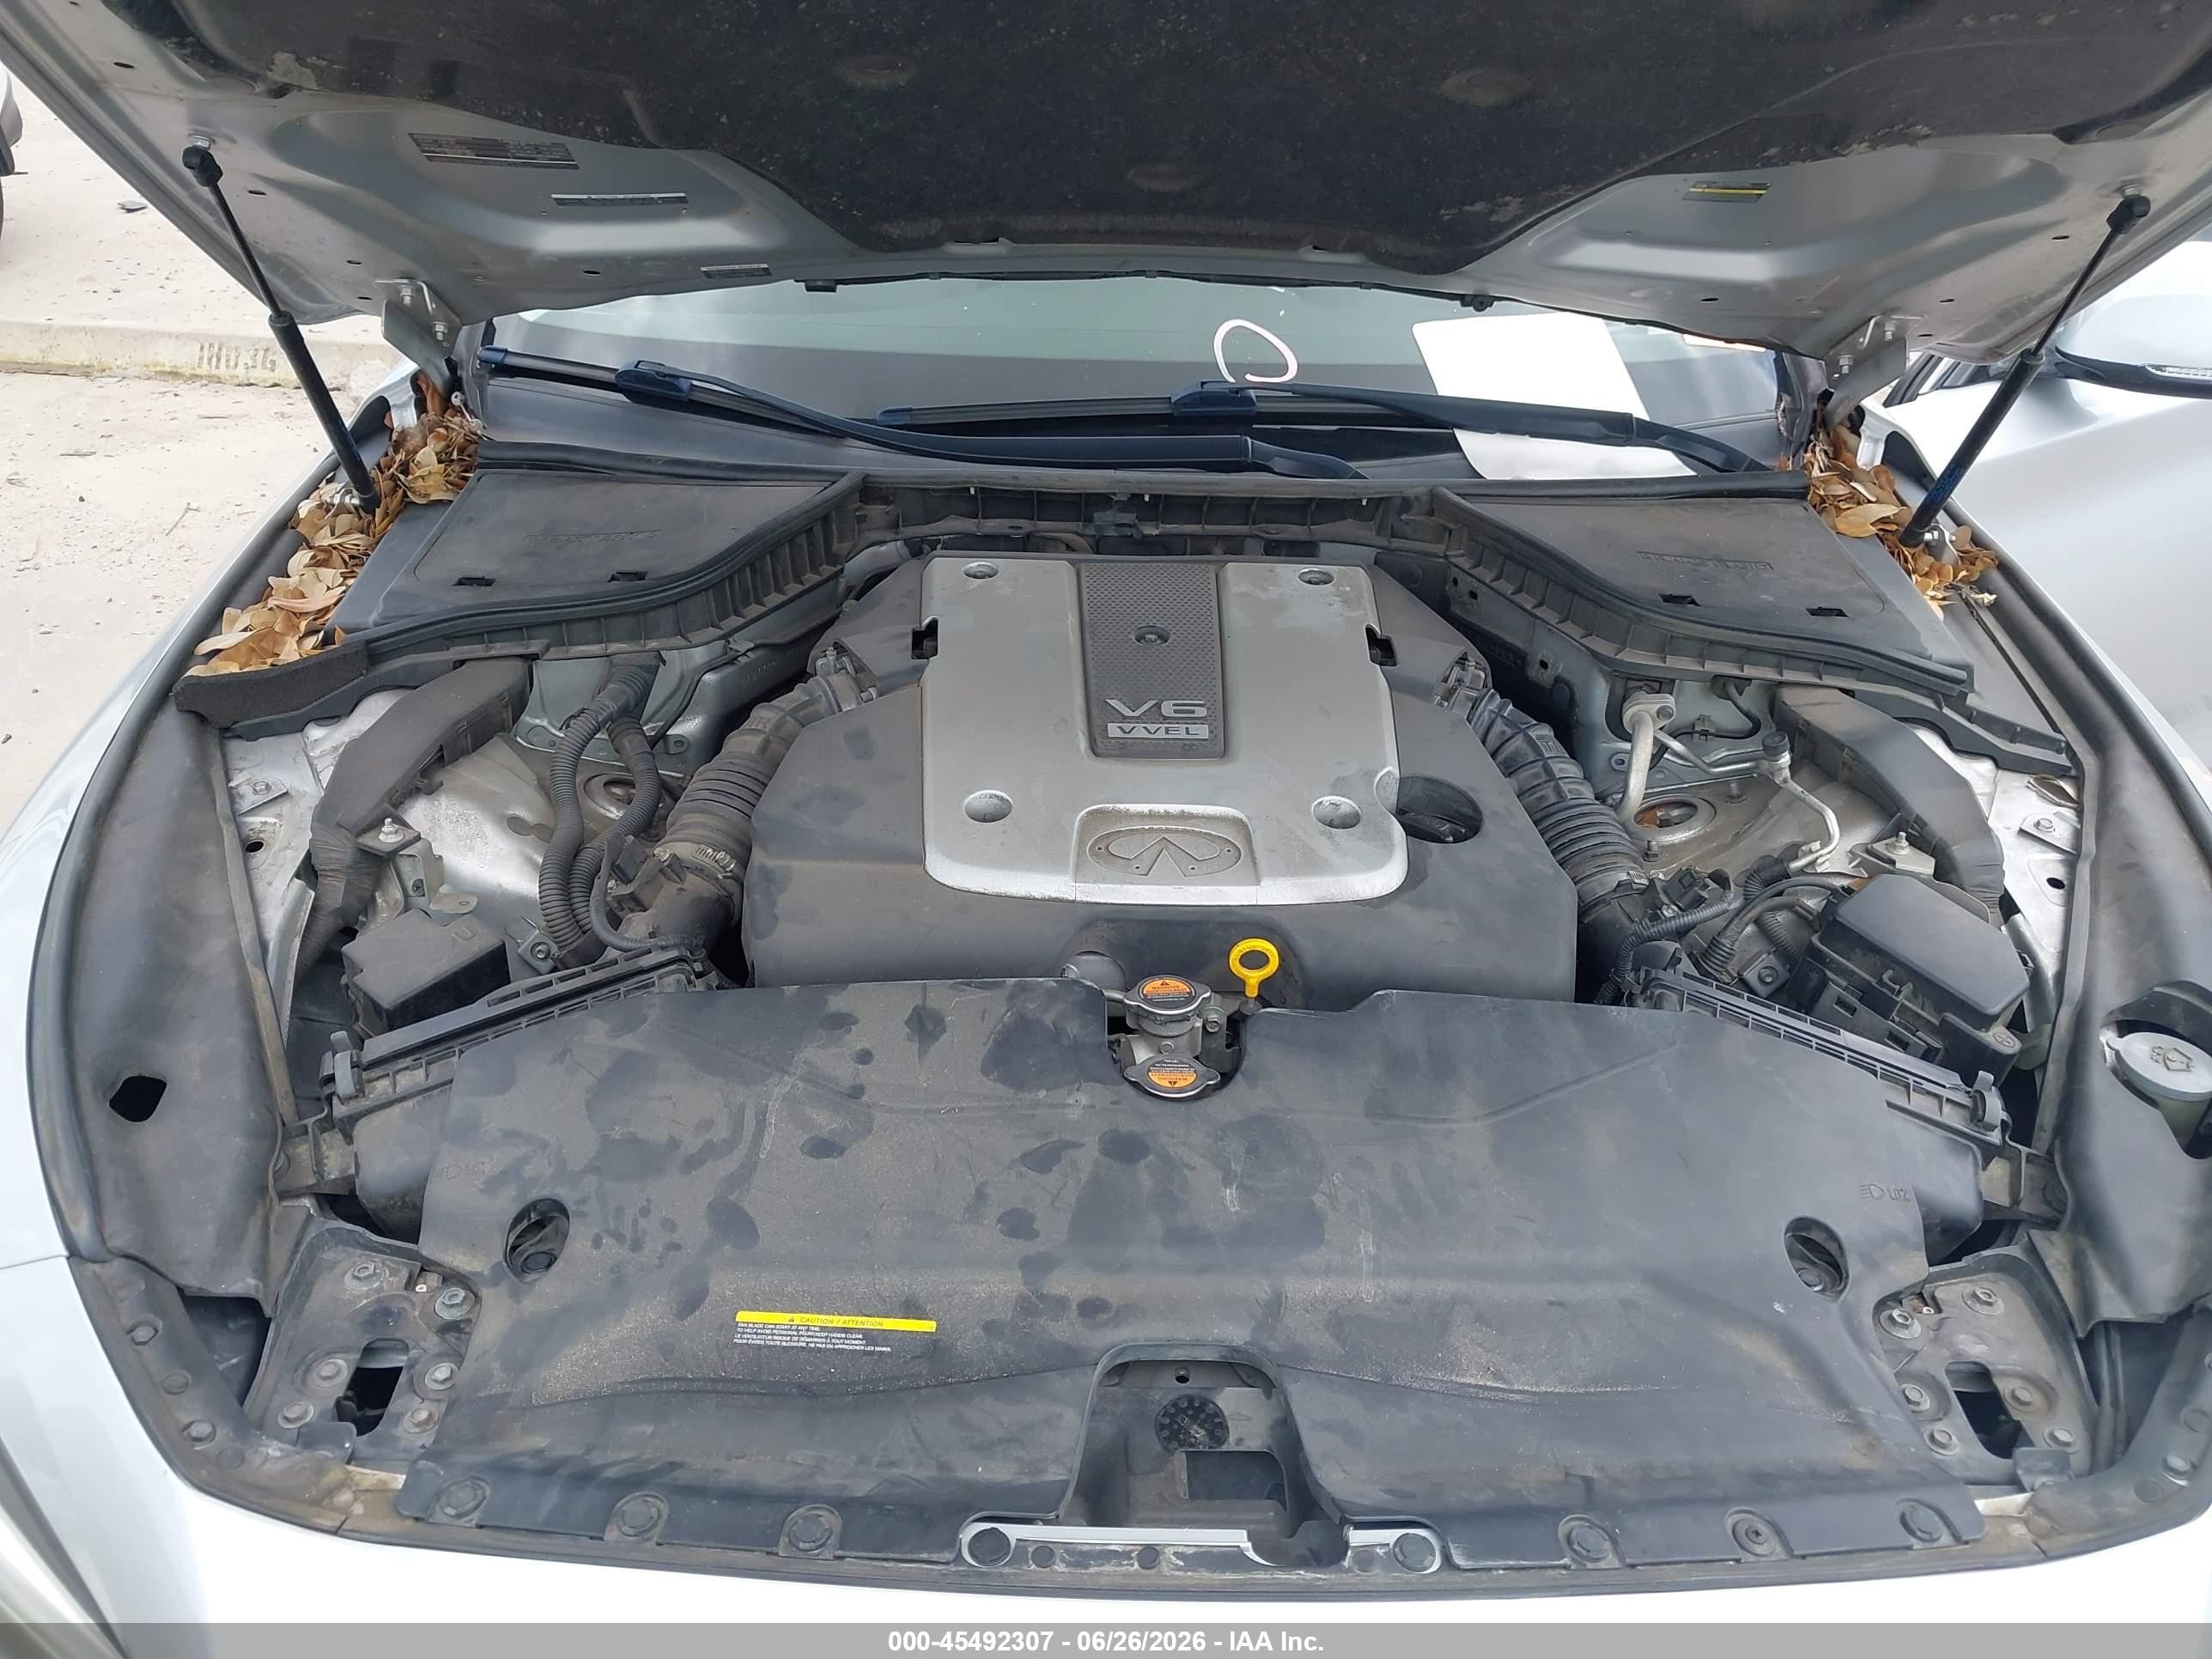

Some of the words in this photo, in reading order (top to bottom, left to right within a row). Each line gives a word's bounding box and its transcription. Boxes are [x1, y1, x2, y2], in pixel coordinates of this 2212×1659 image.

[1104, 698, 1207, 718] V6
[1116, 726, 1200, 736] VVEL
[799, 1316, 833, 1325] CAUTION
